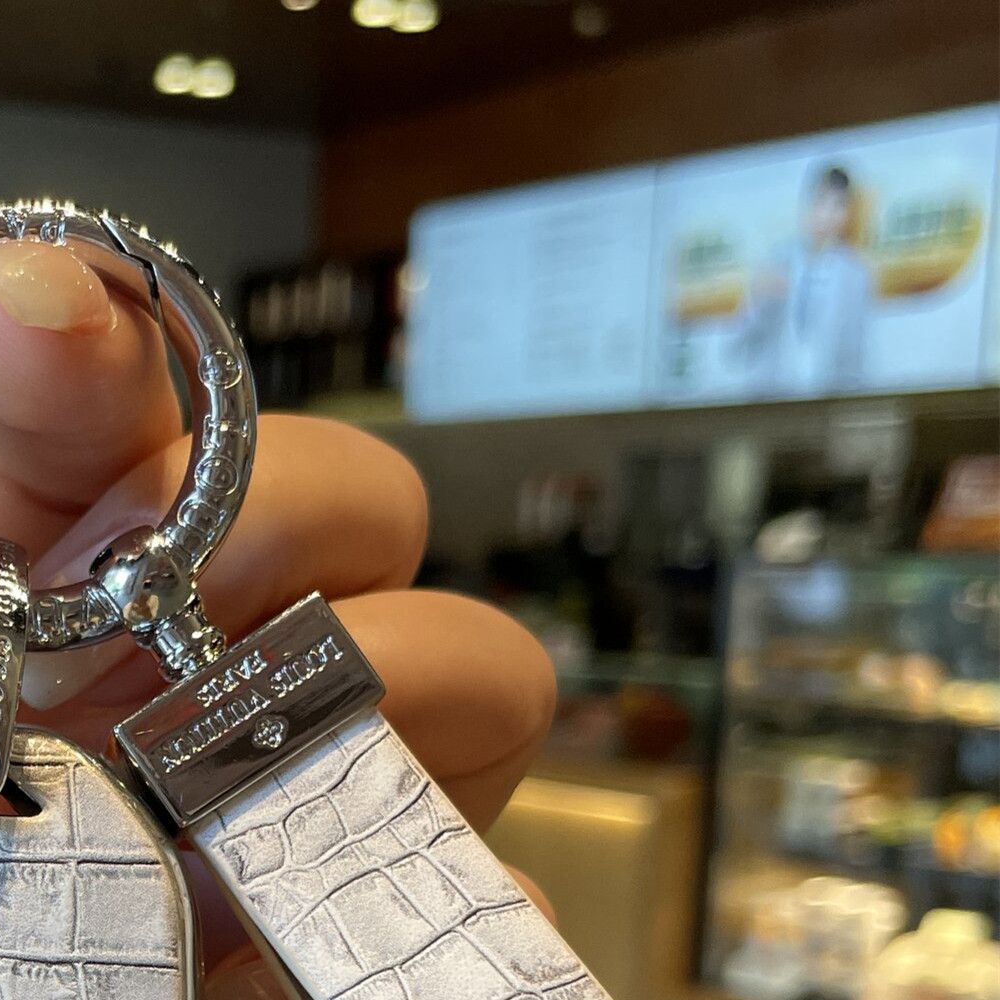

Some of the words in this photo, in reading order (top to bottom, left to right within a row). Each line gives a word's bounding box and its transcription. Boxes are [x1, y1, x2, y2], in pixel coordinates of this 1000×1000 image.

[197, 650, 269, 707] PARIS
[270, 635, 345, 698] LOUIS
[160, 689, 272, 774] VUITTON
